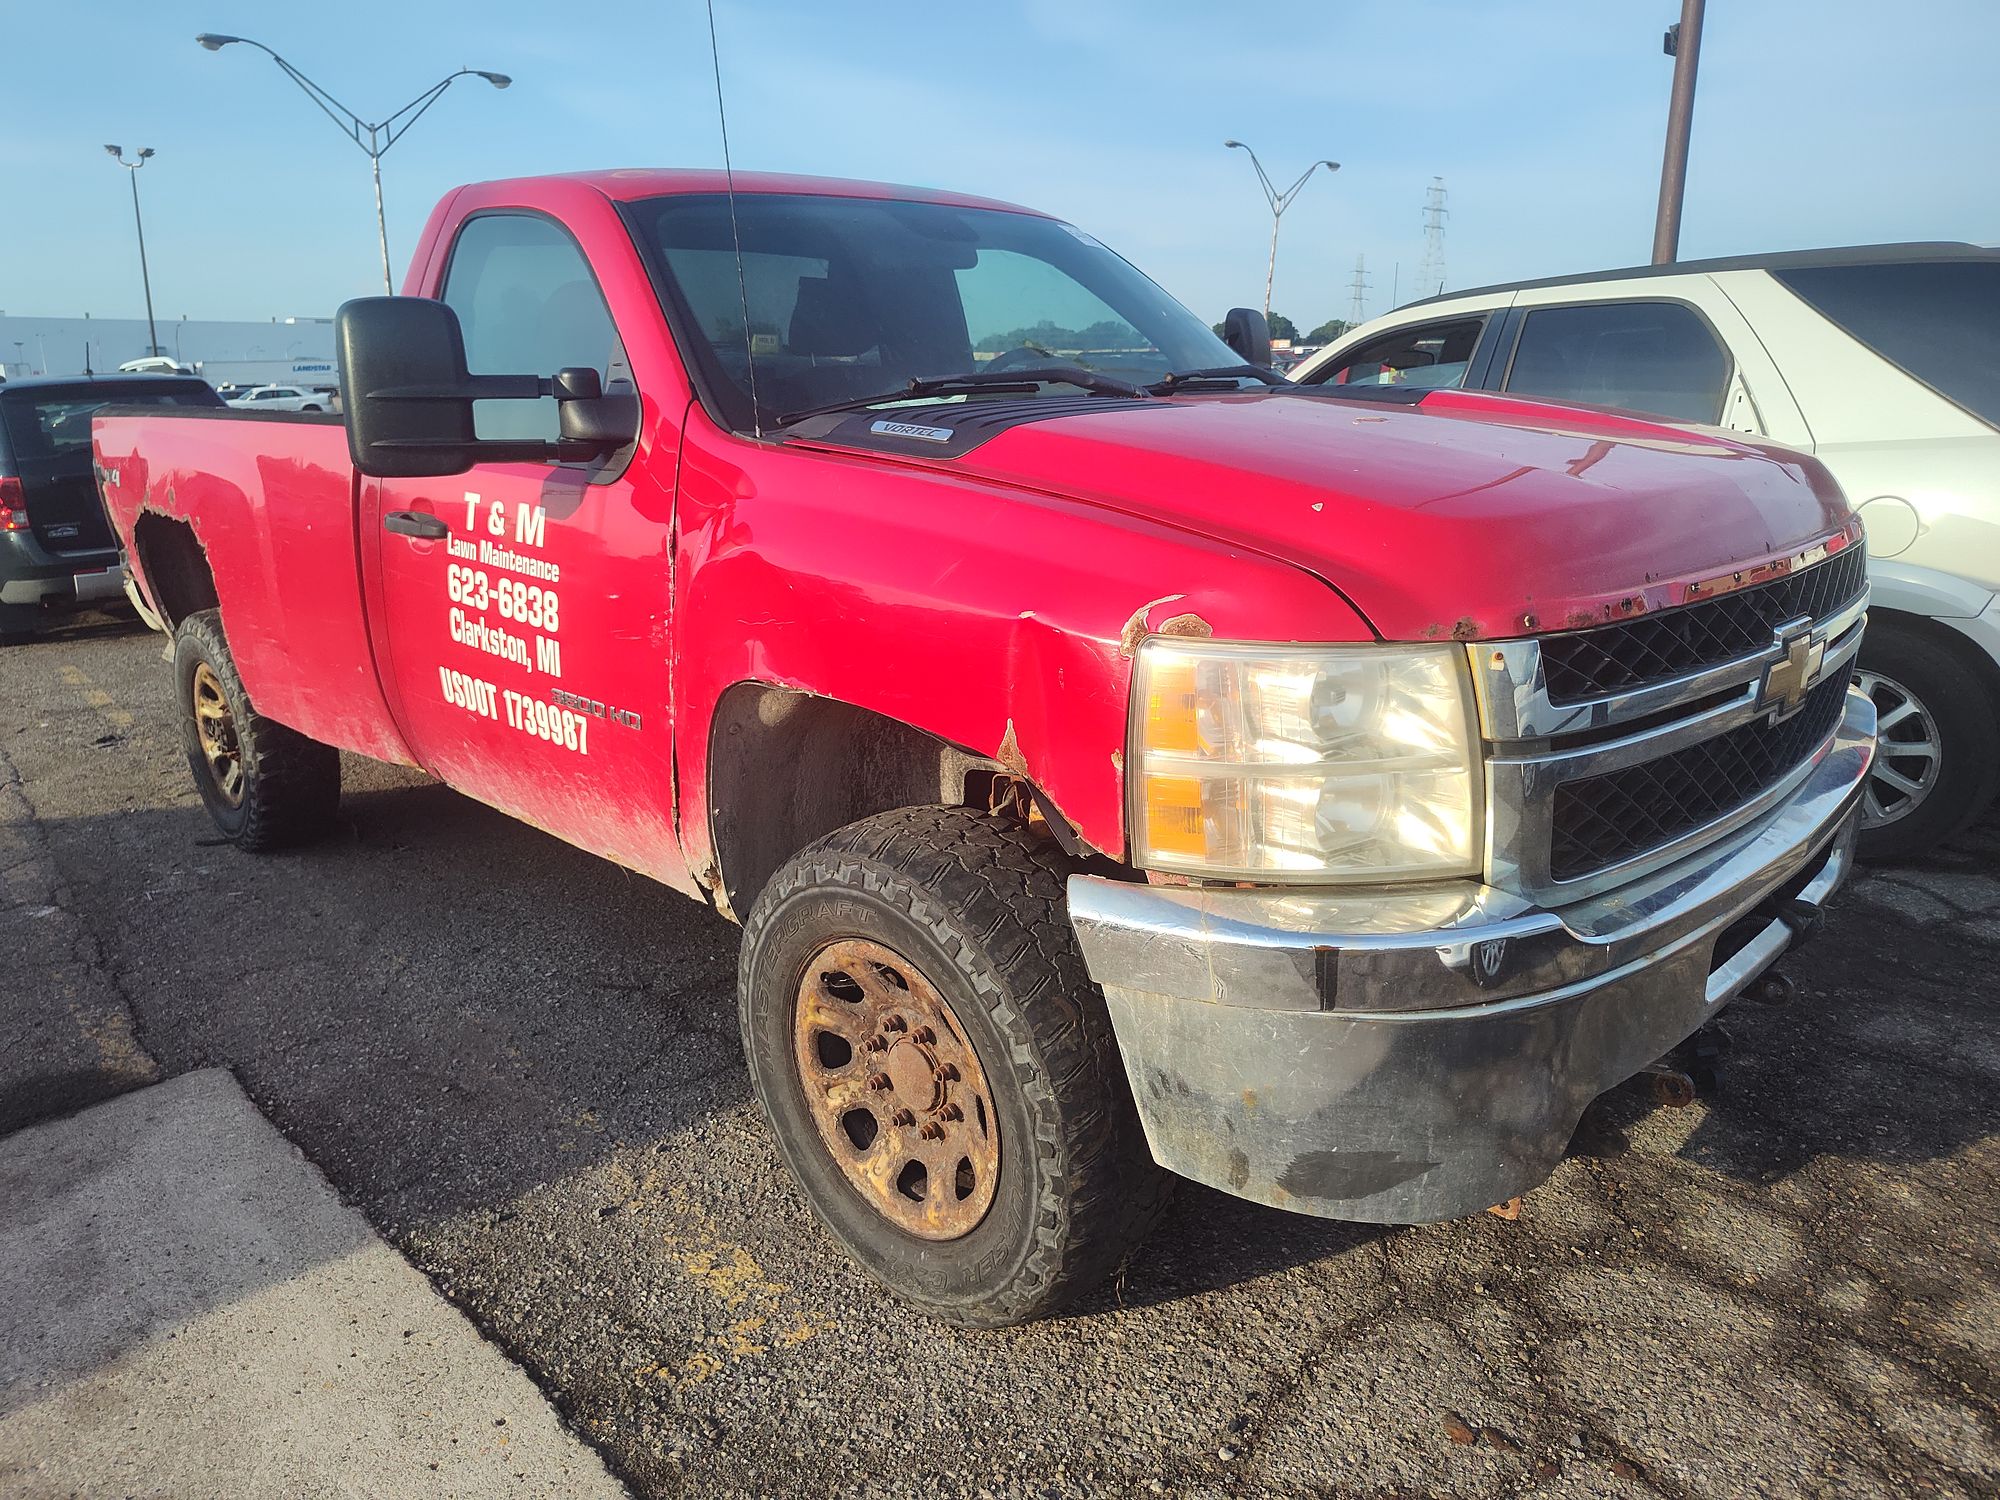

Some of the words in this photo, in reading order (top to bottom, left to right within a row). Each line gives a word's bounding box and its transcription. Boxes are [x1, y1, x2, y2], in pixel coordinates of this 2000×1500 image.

[884, 423, 940, 437] VORTEC
[464, 492, 480, 531] T
[487, 500, 505, 536] &
[515, 503, 546, 547] M
[446, 531, 477, 561] Lawn
[479, 539, 560, 583] Maintenance
[447, 563, 559, 633] 623-6838
[449, 607, 532, 673] Clarkston,
[536, 635, 562, 678] MI
[439, 666, 498, 721] USDOT
[502, 689, 588, 755] 1739987
[551, 688, 607, 719] 3500
[609, 706, 642, 730] HD
[756, 900, 877, 1073] MASTERCRAFT
